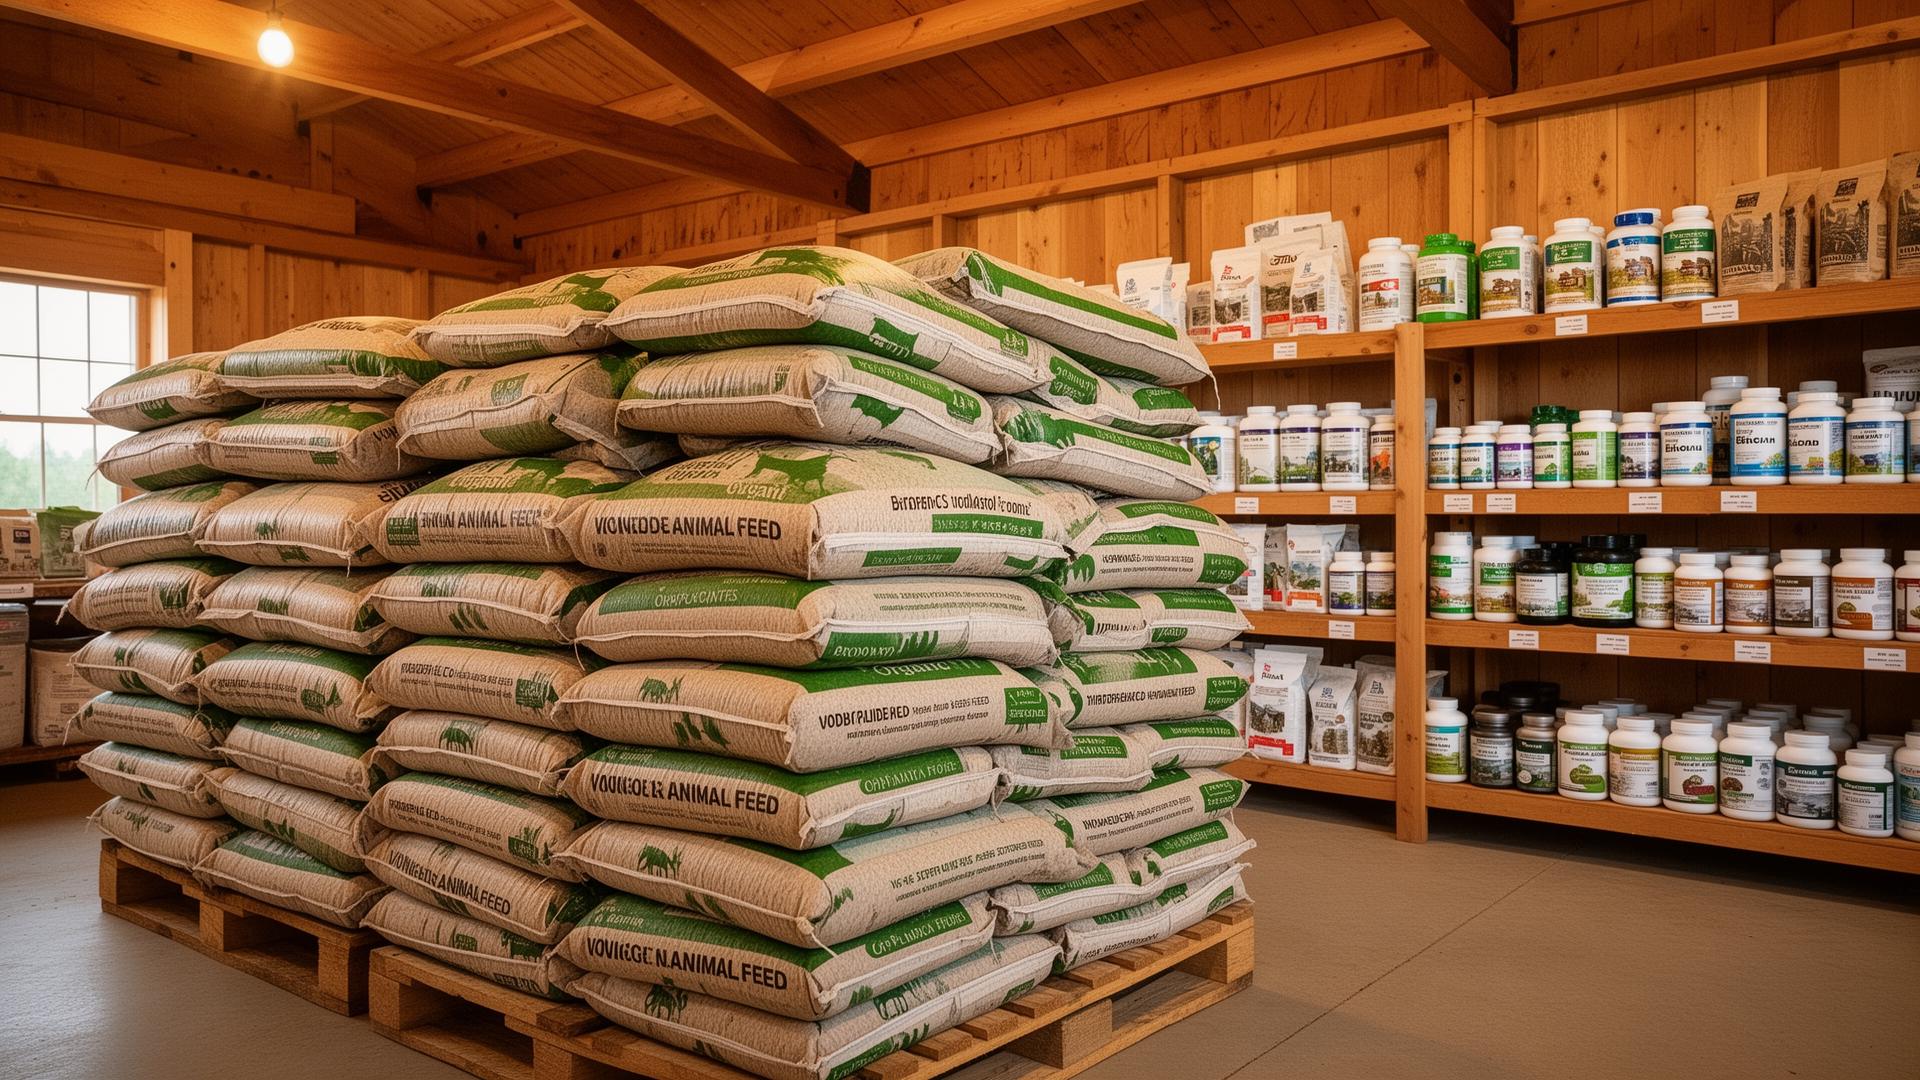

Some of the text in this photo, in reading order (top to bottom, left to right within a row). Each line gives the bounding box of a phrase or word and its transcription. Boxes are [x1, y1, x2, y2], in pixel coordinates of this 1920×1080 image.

[457, 510, 508, 530] ANIMAL
[672, 516, 735, 537] ANIMAL
[736, 517, 782, 541] FEED
[667, 778, 732, 808] ANIMAL
[734, 789, 779, 816] FEED
[480, 889, 511, 916] FEED
[741, 962, 788, 991] FEED
